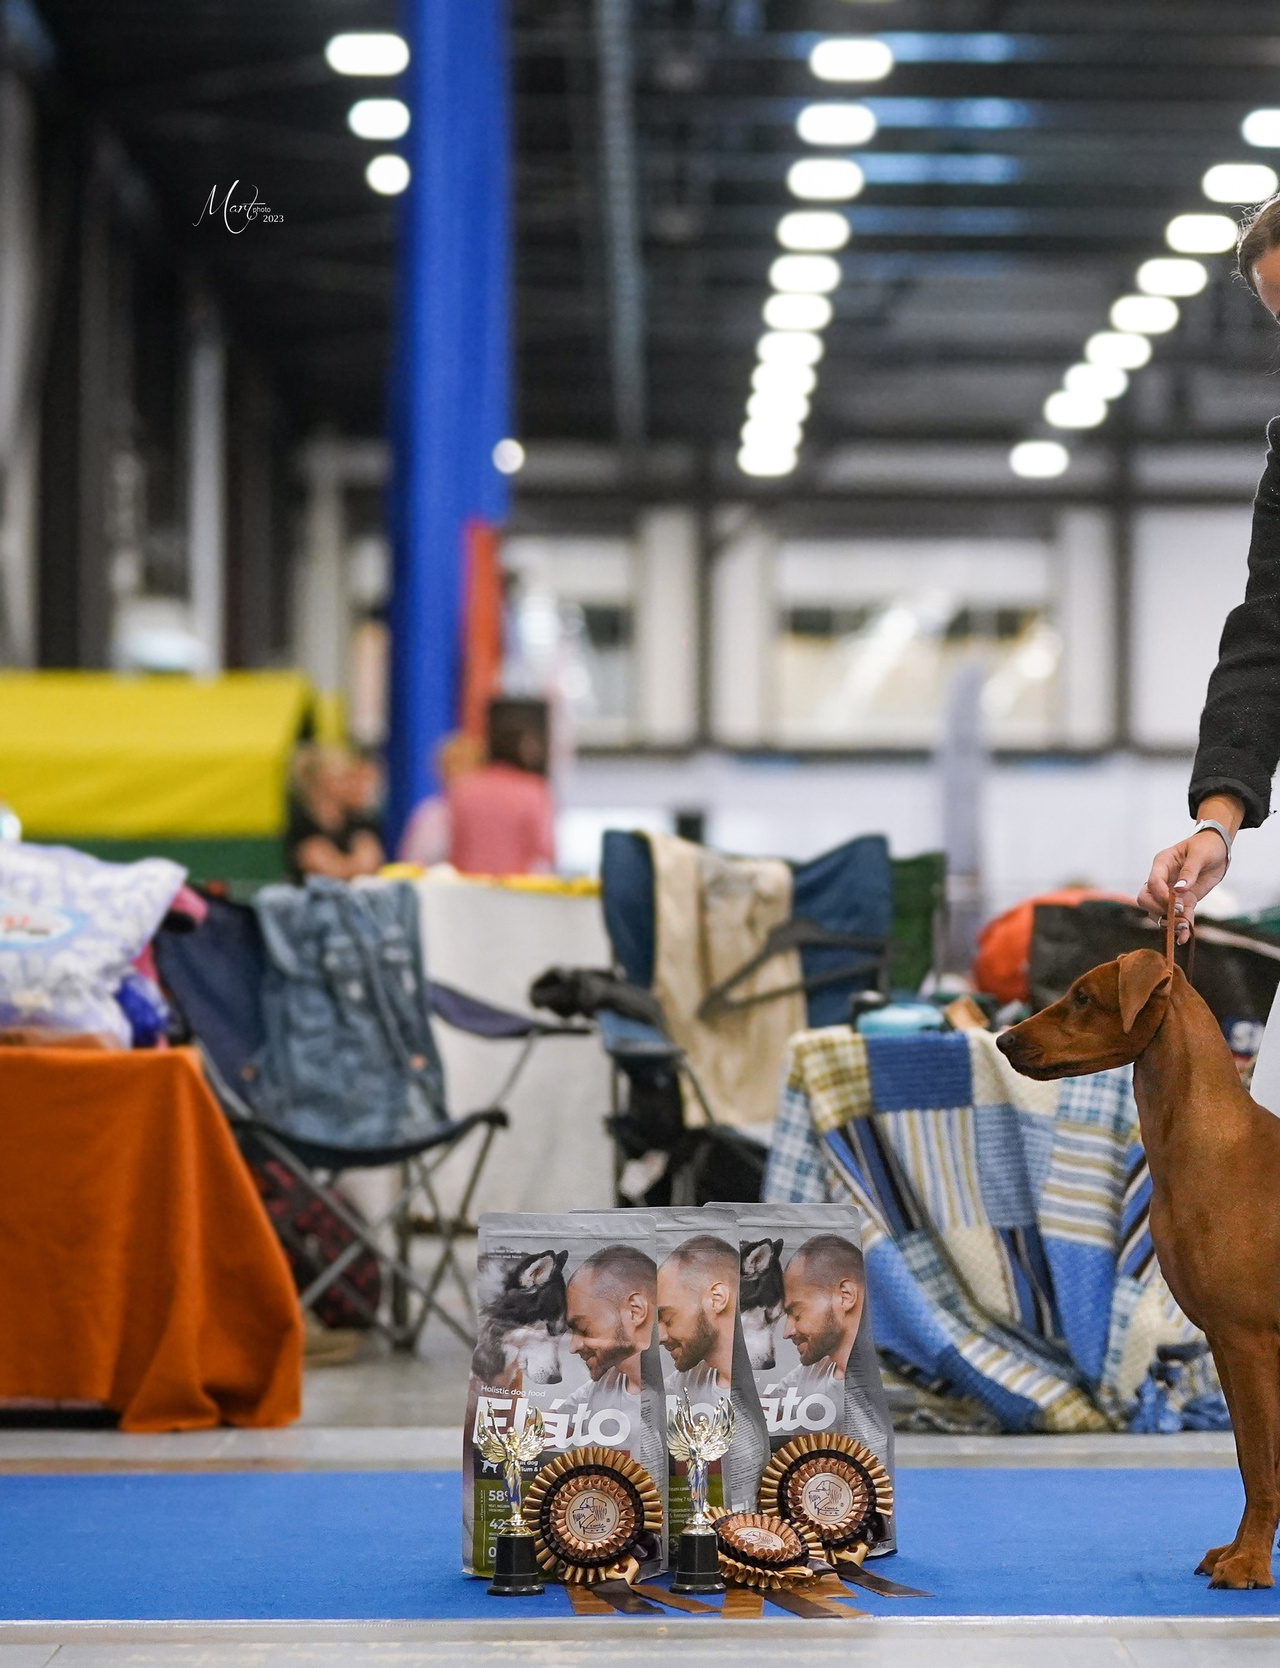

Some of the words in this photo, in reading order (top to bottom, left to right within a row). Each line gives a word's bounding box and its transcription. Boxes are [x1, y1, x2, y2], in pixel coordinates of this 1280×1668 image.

[481, 1384, 509, 1395] Holistic
[510, 1388, 526, 1397] dog
[759, 1383, 837, 1433] áto
[489, 1518, 506, 1530] 42
